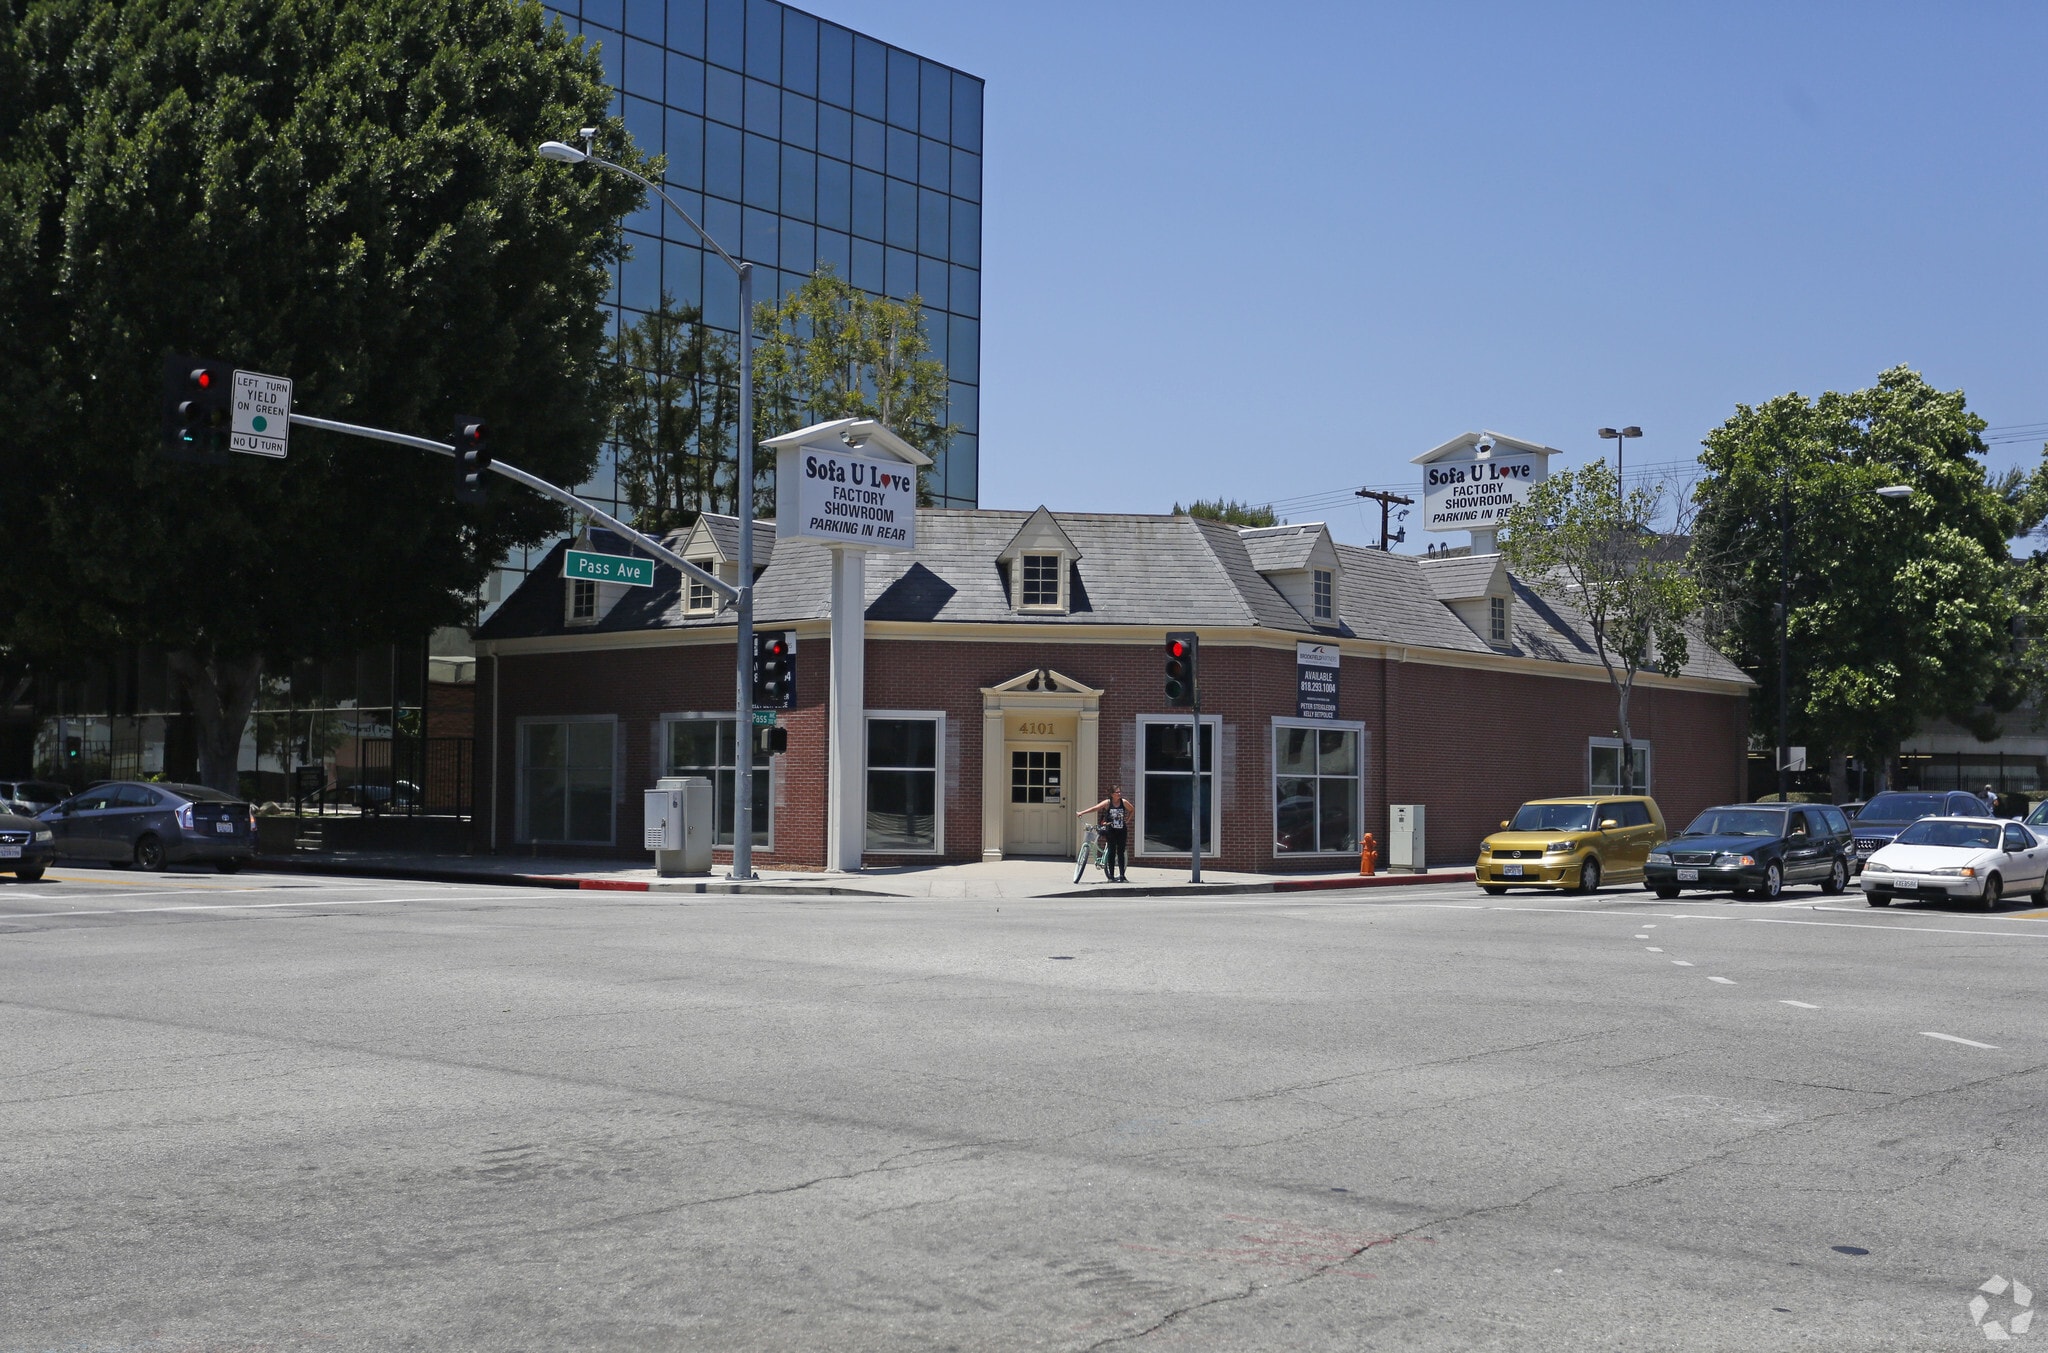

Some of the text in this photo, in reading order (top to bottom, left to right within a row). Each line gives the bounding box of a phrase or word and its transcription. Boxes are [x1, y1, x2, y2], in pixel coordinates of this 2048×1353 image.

[237, 377, 288, 393] LEFT TURN
[247, 389, 277, 404] YIELD
[237, 401, 284, 416] ON GREEN
[233, 437, 283, 452] NO U TURN
[806, 456, 846, 483] Sofa
[851, 462, 865, 485] U
[1428, 467, 1465, 485] Sofa
[1471, 464, 1483, 482] U
[833, 486, 886, 506] FACTORY
[1453, 483, 1504, 497] FACTORY
[1445, 494, 1513, 509] SHOWROOM
[824, 501, 894, 523] SHOWROOM
[1432, 511, 1477, 523] PARKING
[1480, 509, 1493, 519] IN
[809, 517, 906, 540] PARKING IN REAR
[579, 558, 641, 578] Pass Ave
[1304, 670, 1333, 682] AVAILABLE
[752, 713, 768, 724] Pass
[1019, 723, 1055, 735] 4101
